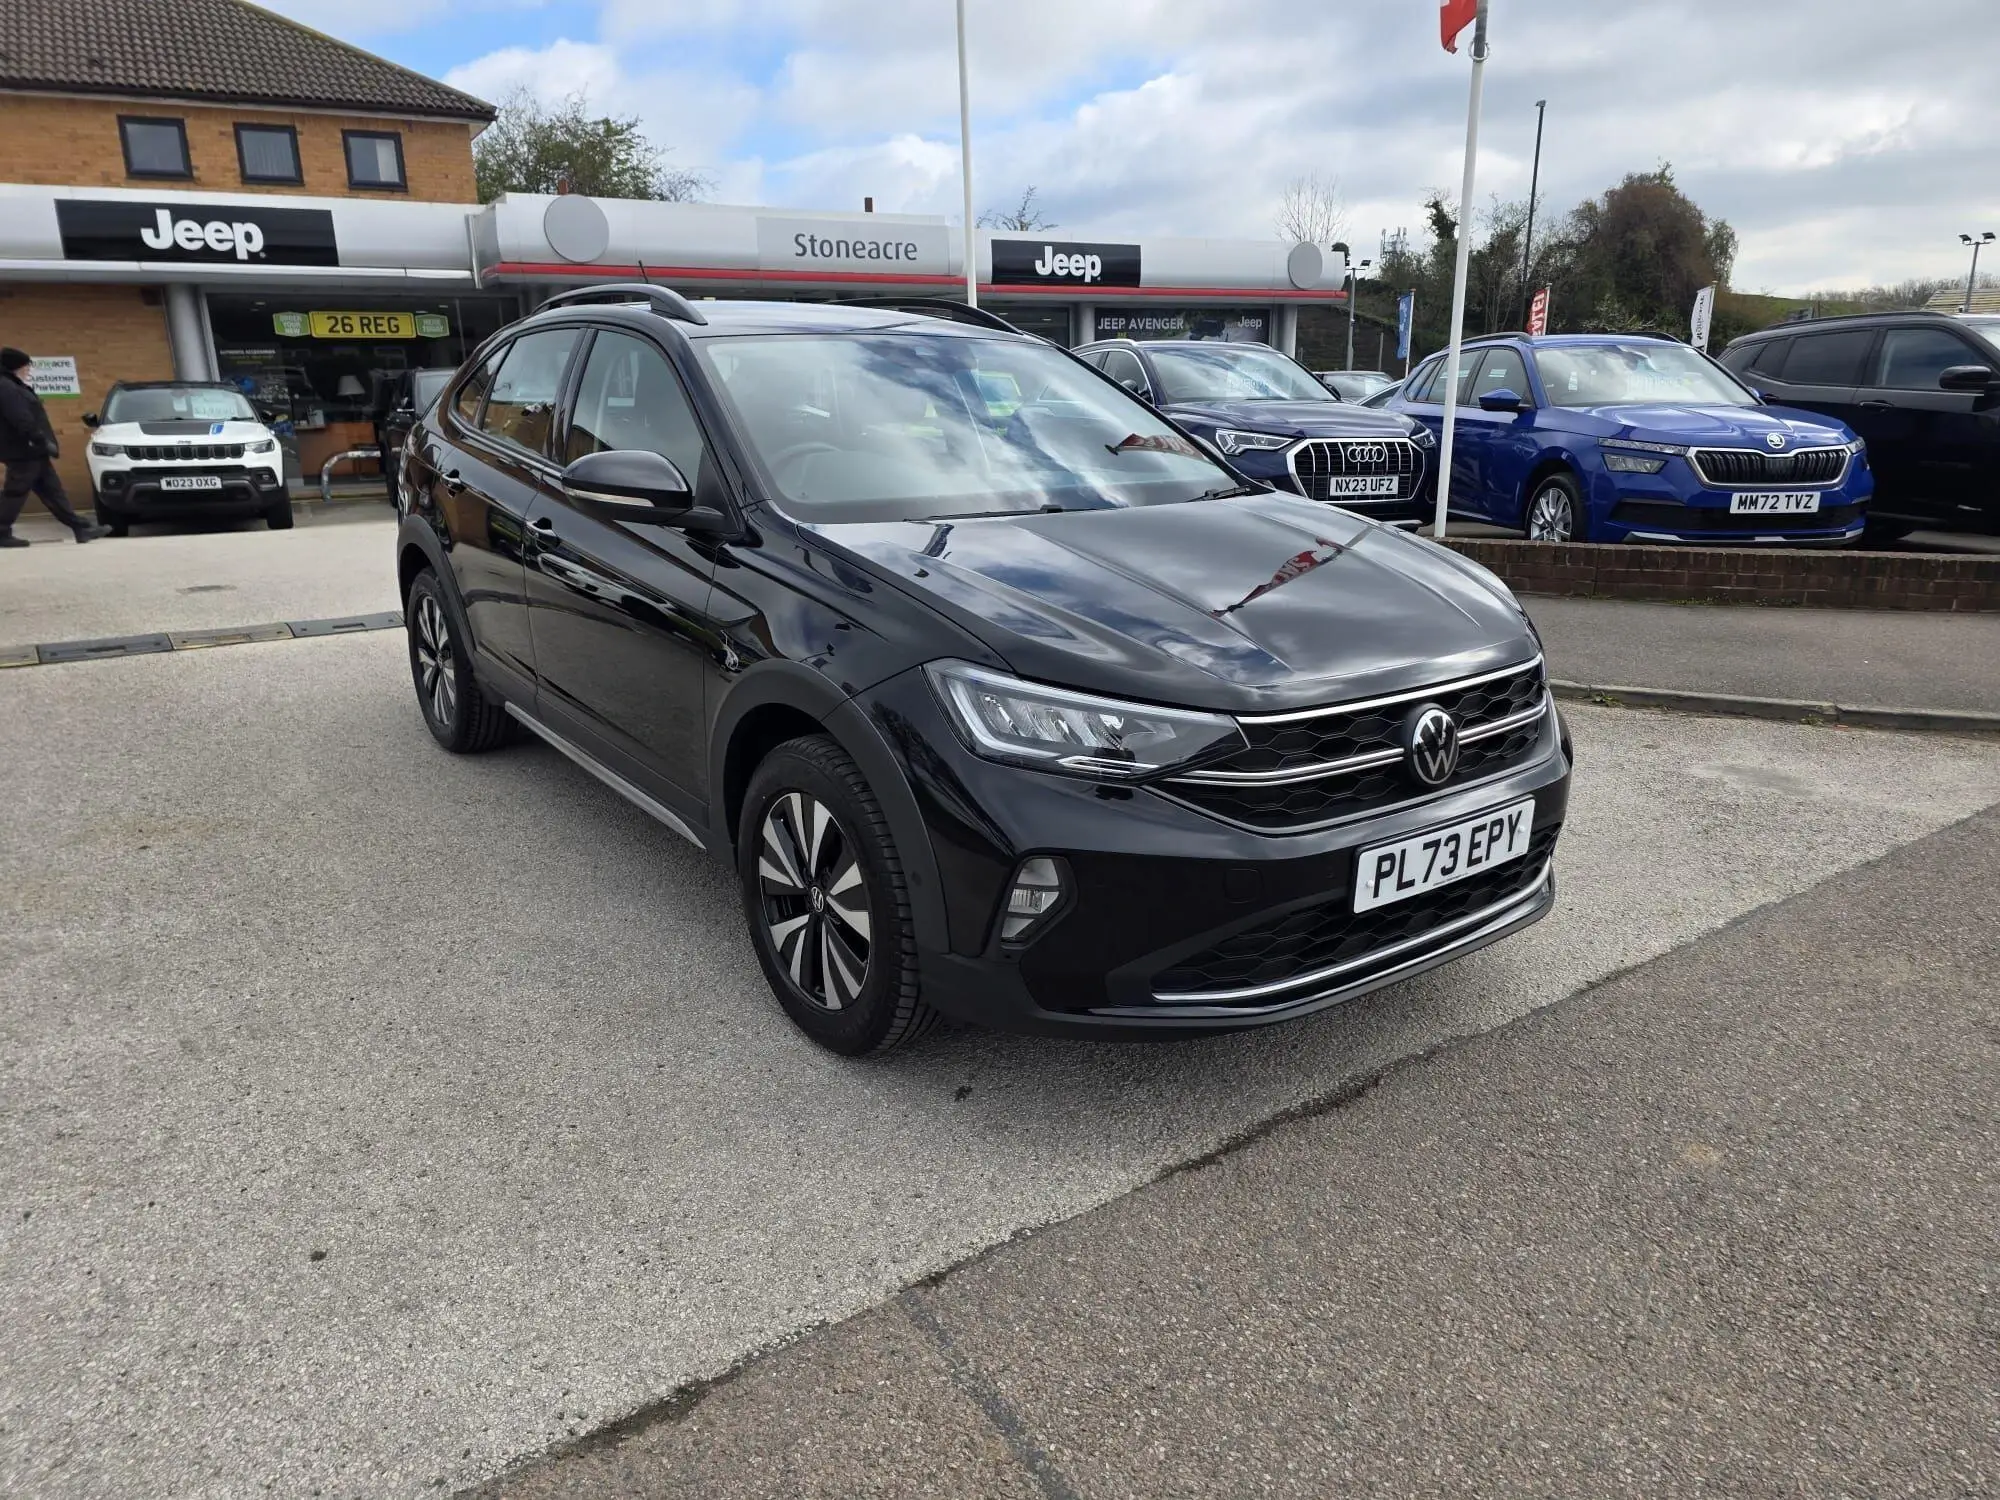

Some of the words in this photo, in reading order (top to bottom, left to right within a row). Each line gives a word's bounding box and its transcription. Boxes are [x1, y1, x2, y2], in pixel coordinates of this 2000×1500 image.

[140, 208, 264, 260] Jeep
[794, 233, 917, 261] Stoneacre
[1035, 246, 1101, 282] Jeep
[327, 316, 353, 334] 26
[359, 316, 400, 334] REG
[1098, 317, 1126, 330] JEEP
[1129, 317, 1184, 330] AVENGER
[1238, 316, 1263, 329] Jeep
[197, 478, 217, 487] OXG
[1335, 479, 1367, 492] NX23
[1370, 478, 1394, 491] UFZ
[1737, 494, 1780, 510] MM72
[1785, 494, 1814, 509] TVZ
[1373, 833, 1461, 899] PL73
[1466, 810, 1523, 868] EPY
